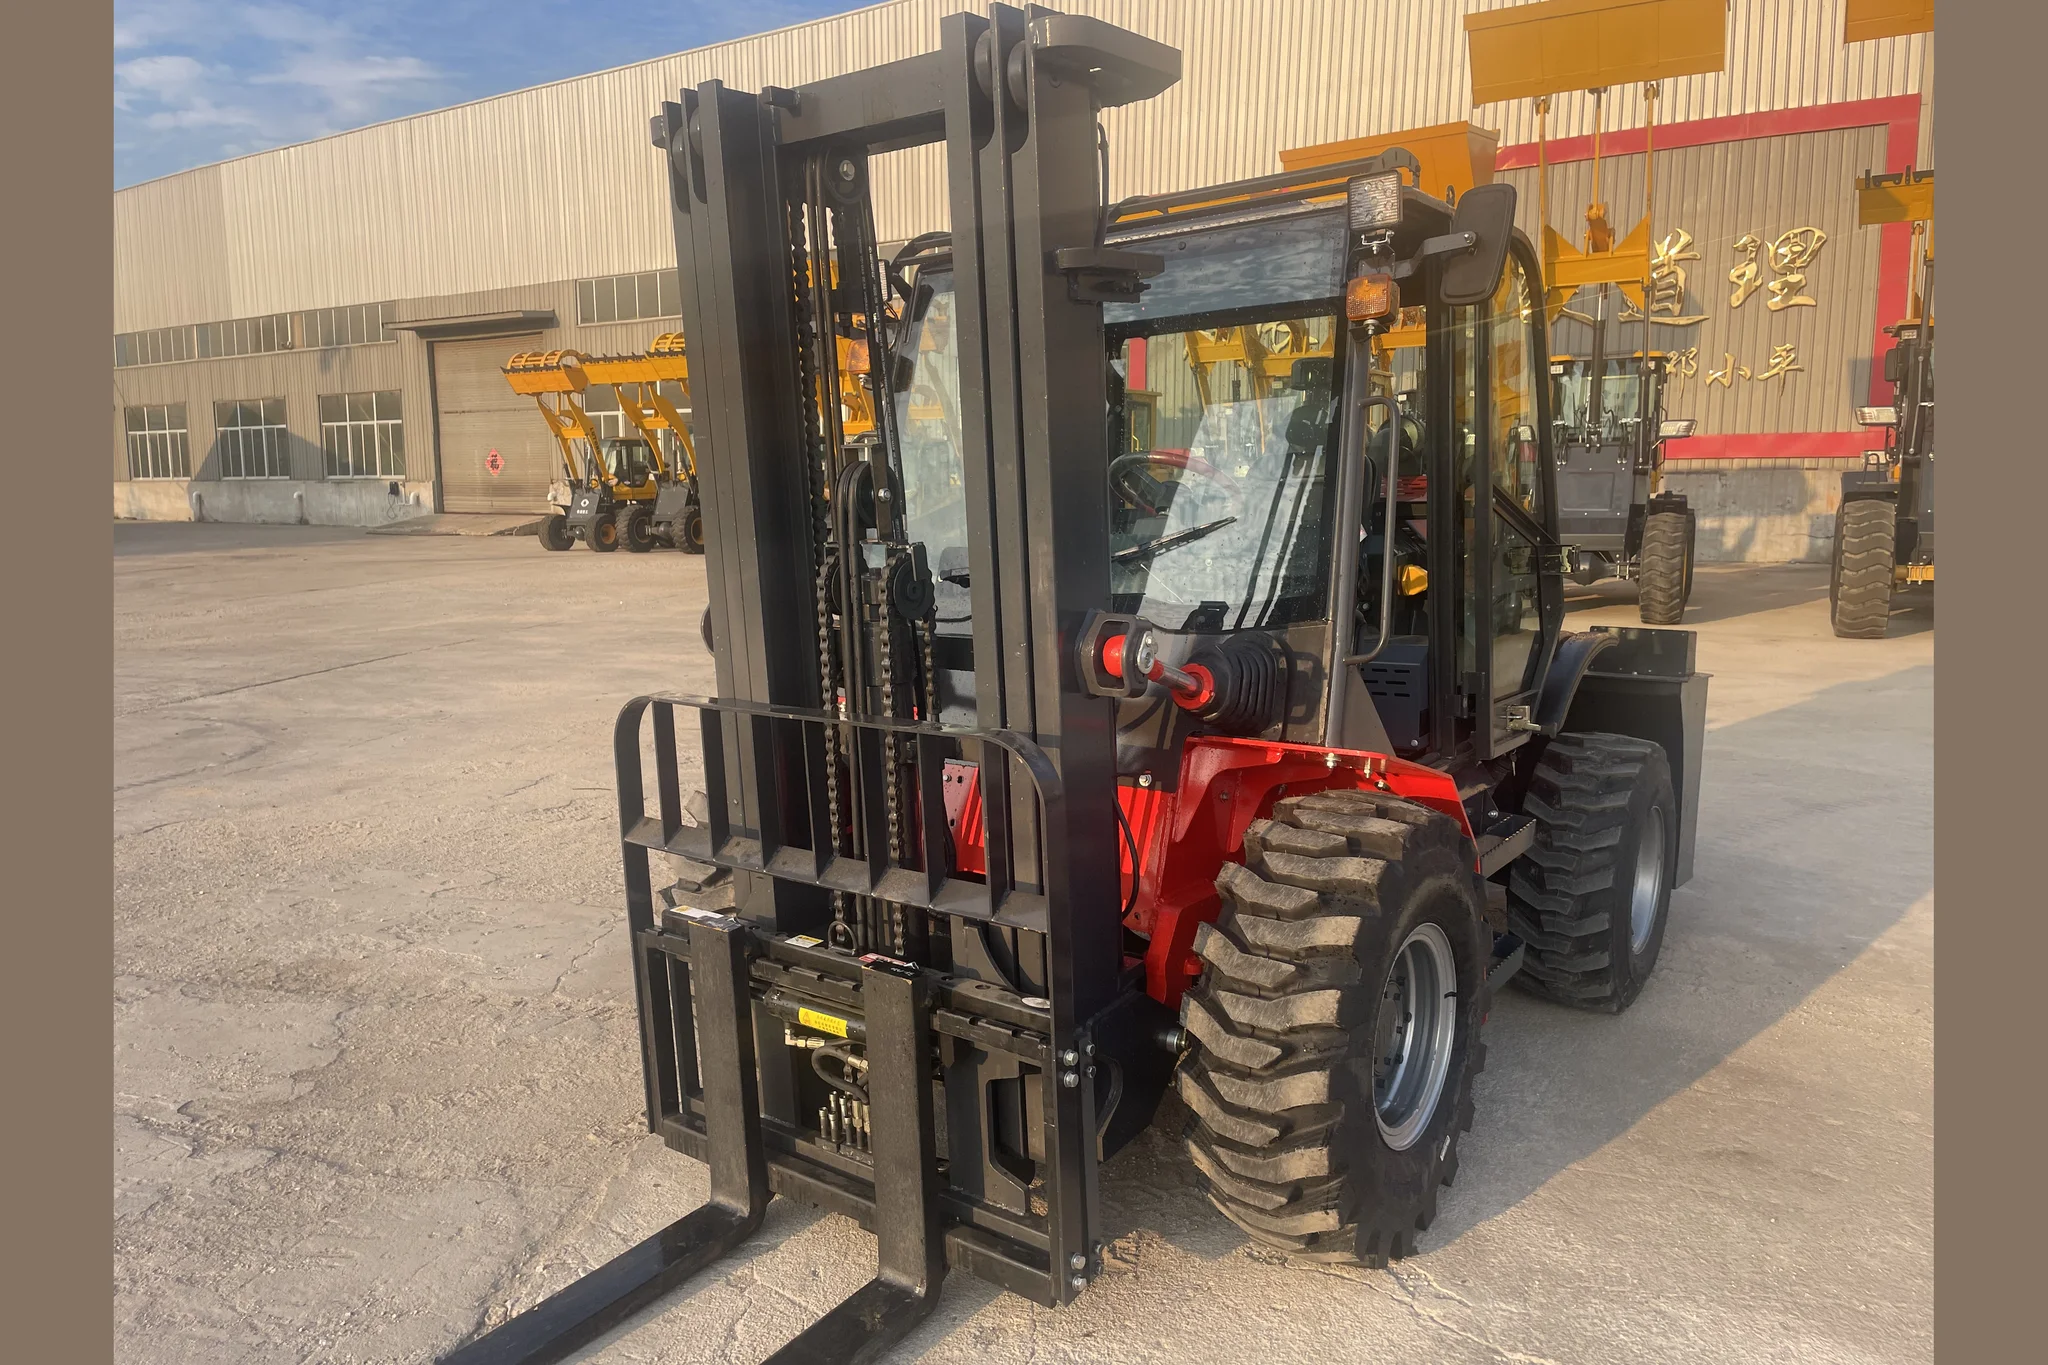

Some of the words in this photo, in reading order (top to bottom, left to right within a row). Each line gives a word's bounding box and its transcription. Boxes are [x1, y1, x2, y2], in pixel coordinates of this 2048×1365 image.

[1551, 228, 1828, 326] 道理
[1665, 343, 1804, 400] 邓小平
